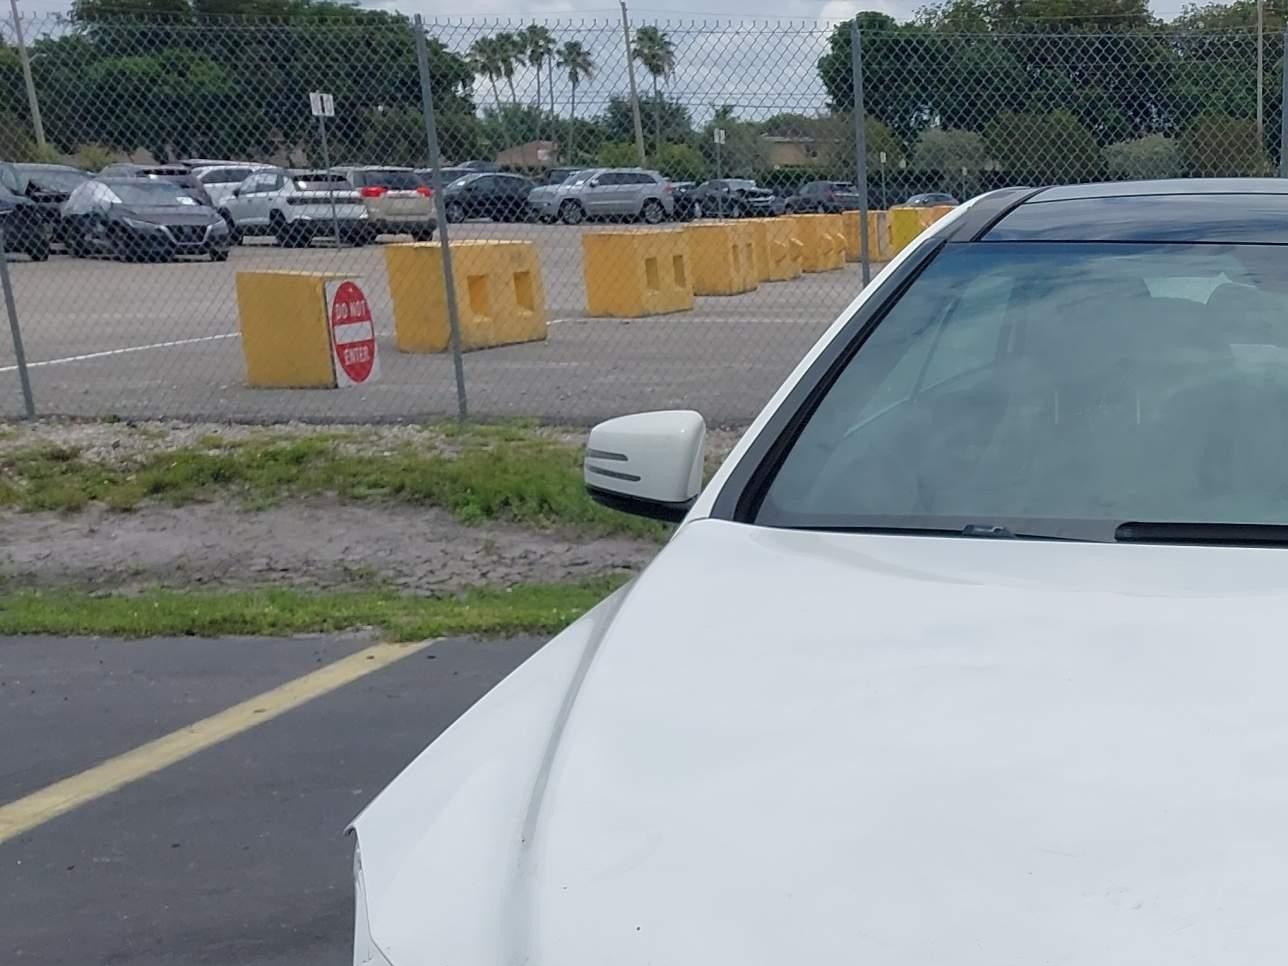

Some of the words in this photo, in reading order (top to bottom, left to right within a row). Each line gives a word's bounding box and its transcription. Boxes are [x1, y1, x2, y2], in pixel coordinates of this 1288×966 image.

[336, 302, 348, 319] DO
[350, 300, 366, 317] NOT
[344, 345, 370, 365] ENTER
